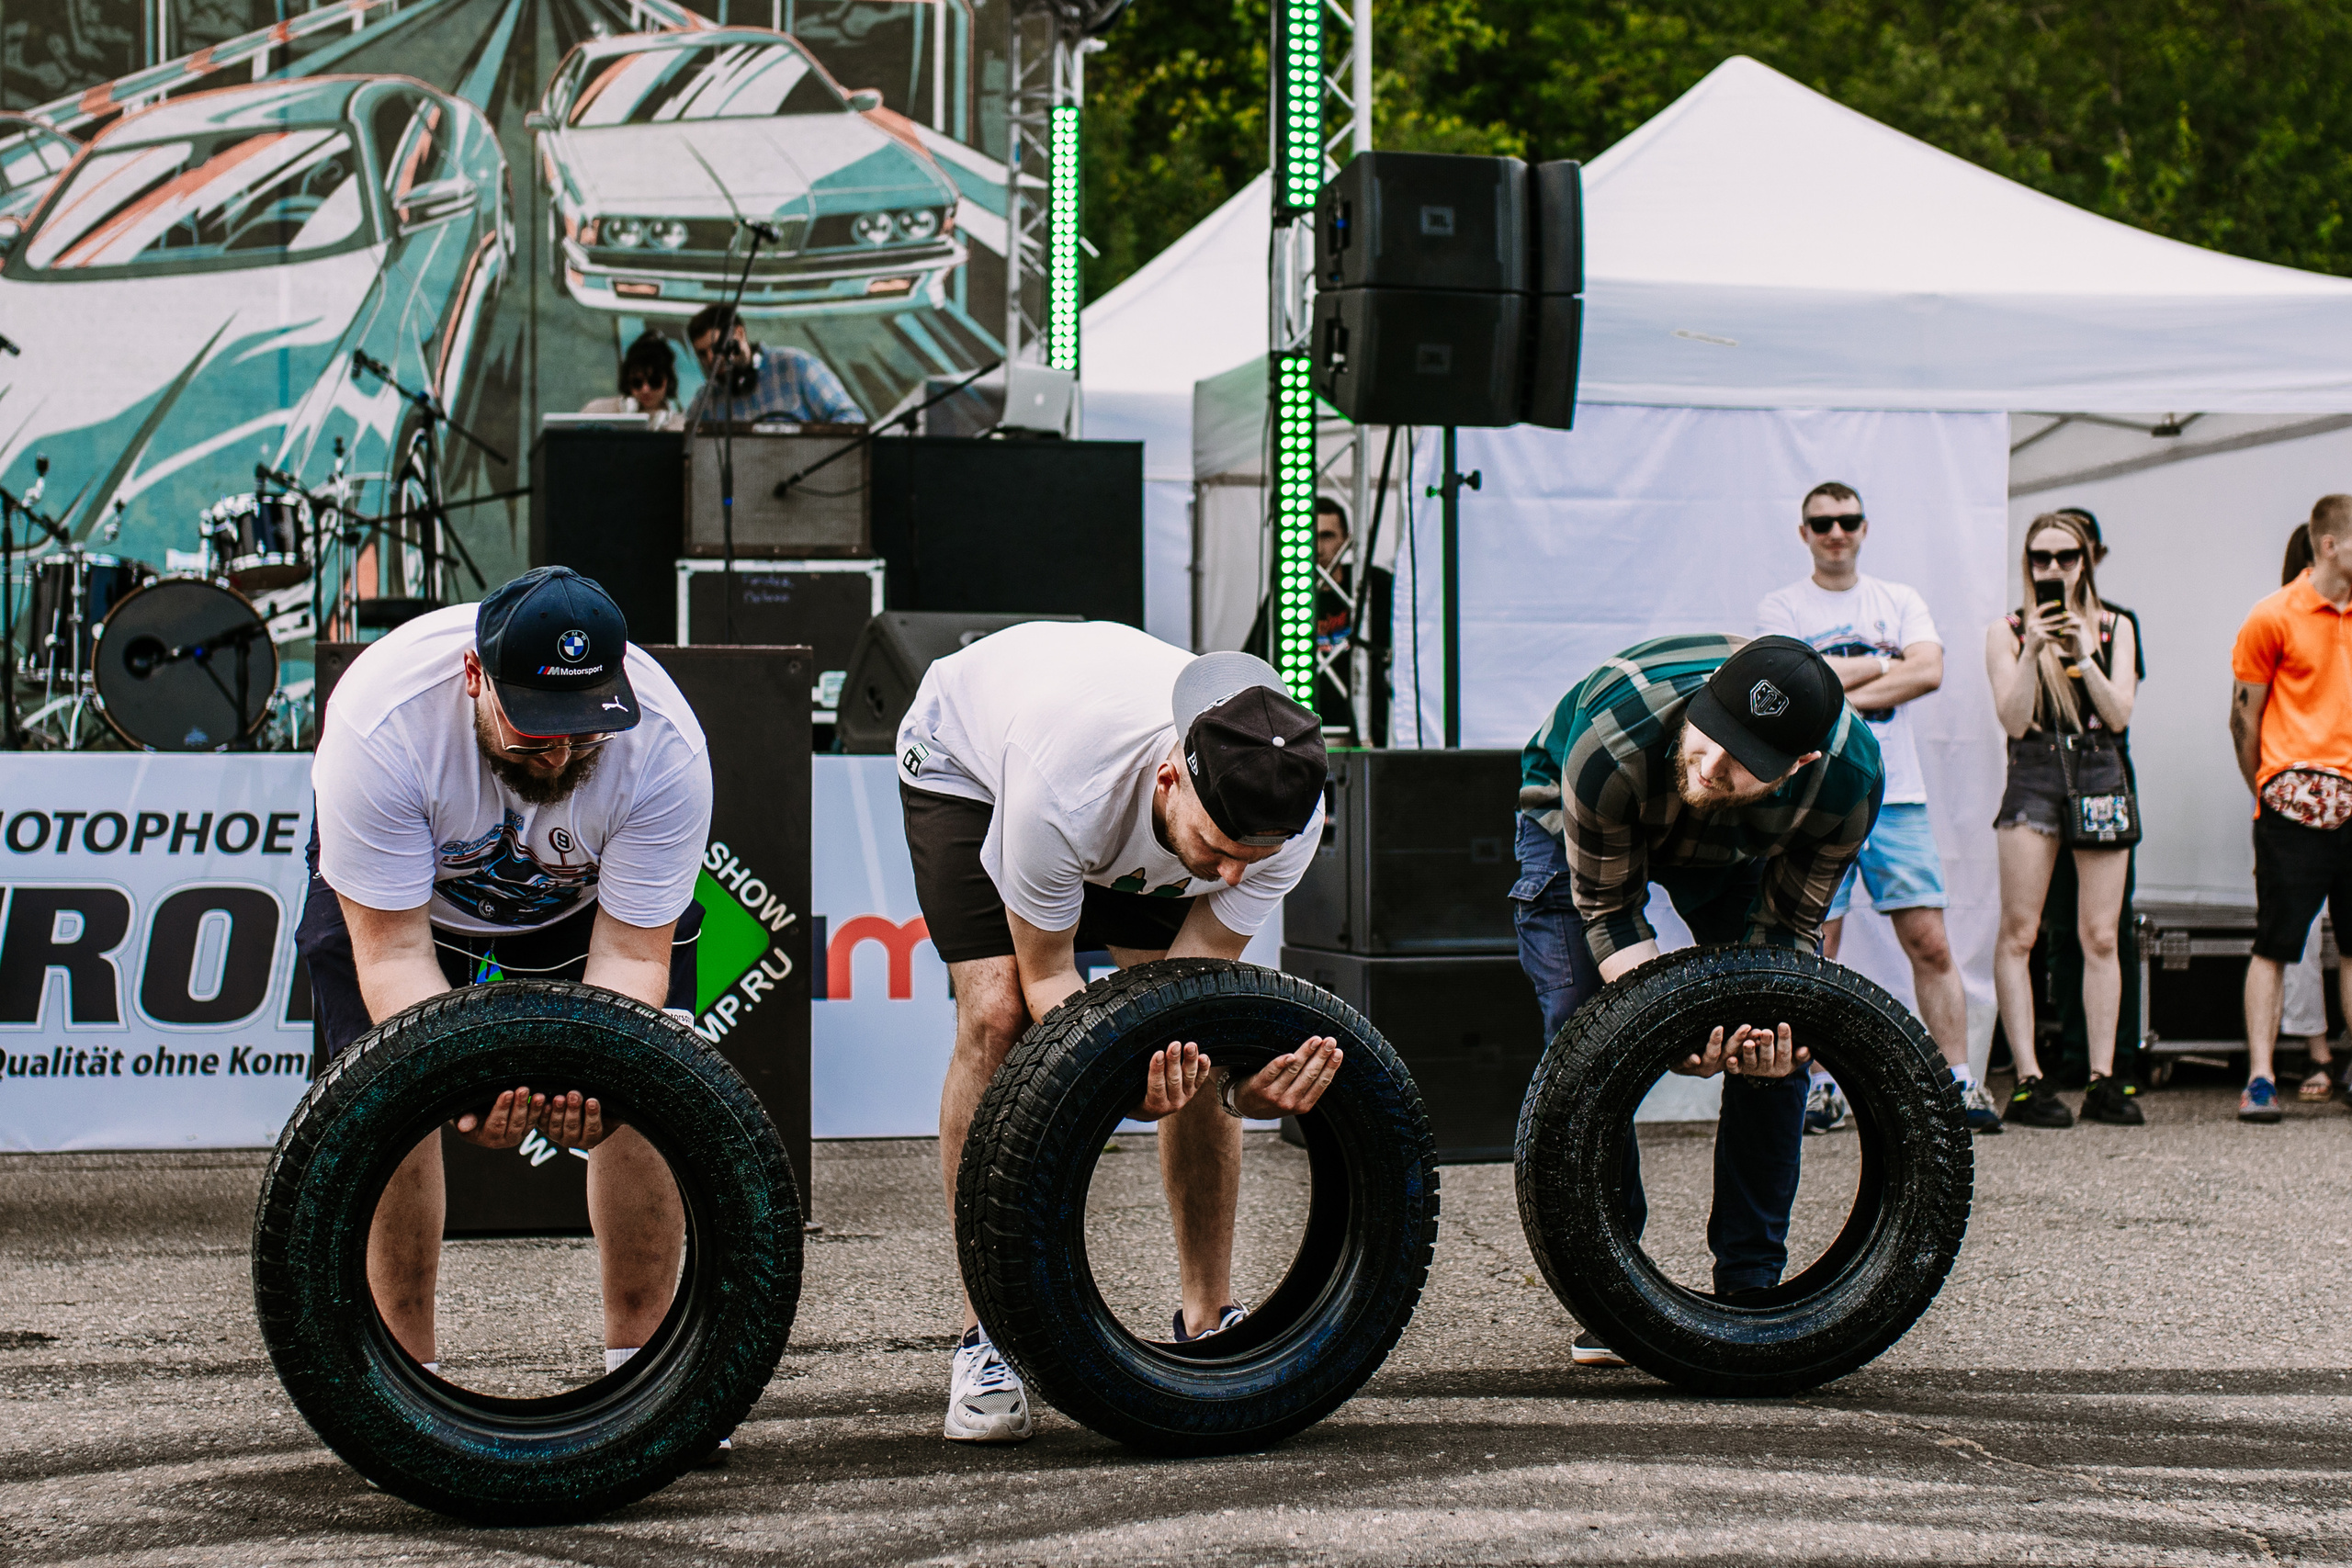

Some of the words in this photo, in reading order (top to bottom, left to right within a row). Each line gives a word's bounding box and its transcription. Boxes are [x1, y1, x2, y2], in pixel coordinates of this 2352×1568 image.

[561, 631, 587, 642] BMW
[560, 664, 604, 676] Motorsport
[0, 810, 300, 855] ОТОРНОЕ
[558, 831, 570, 849] 9
[131, 1044, 220, 1077] ohne
